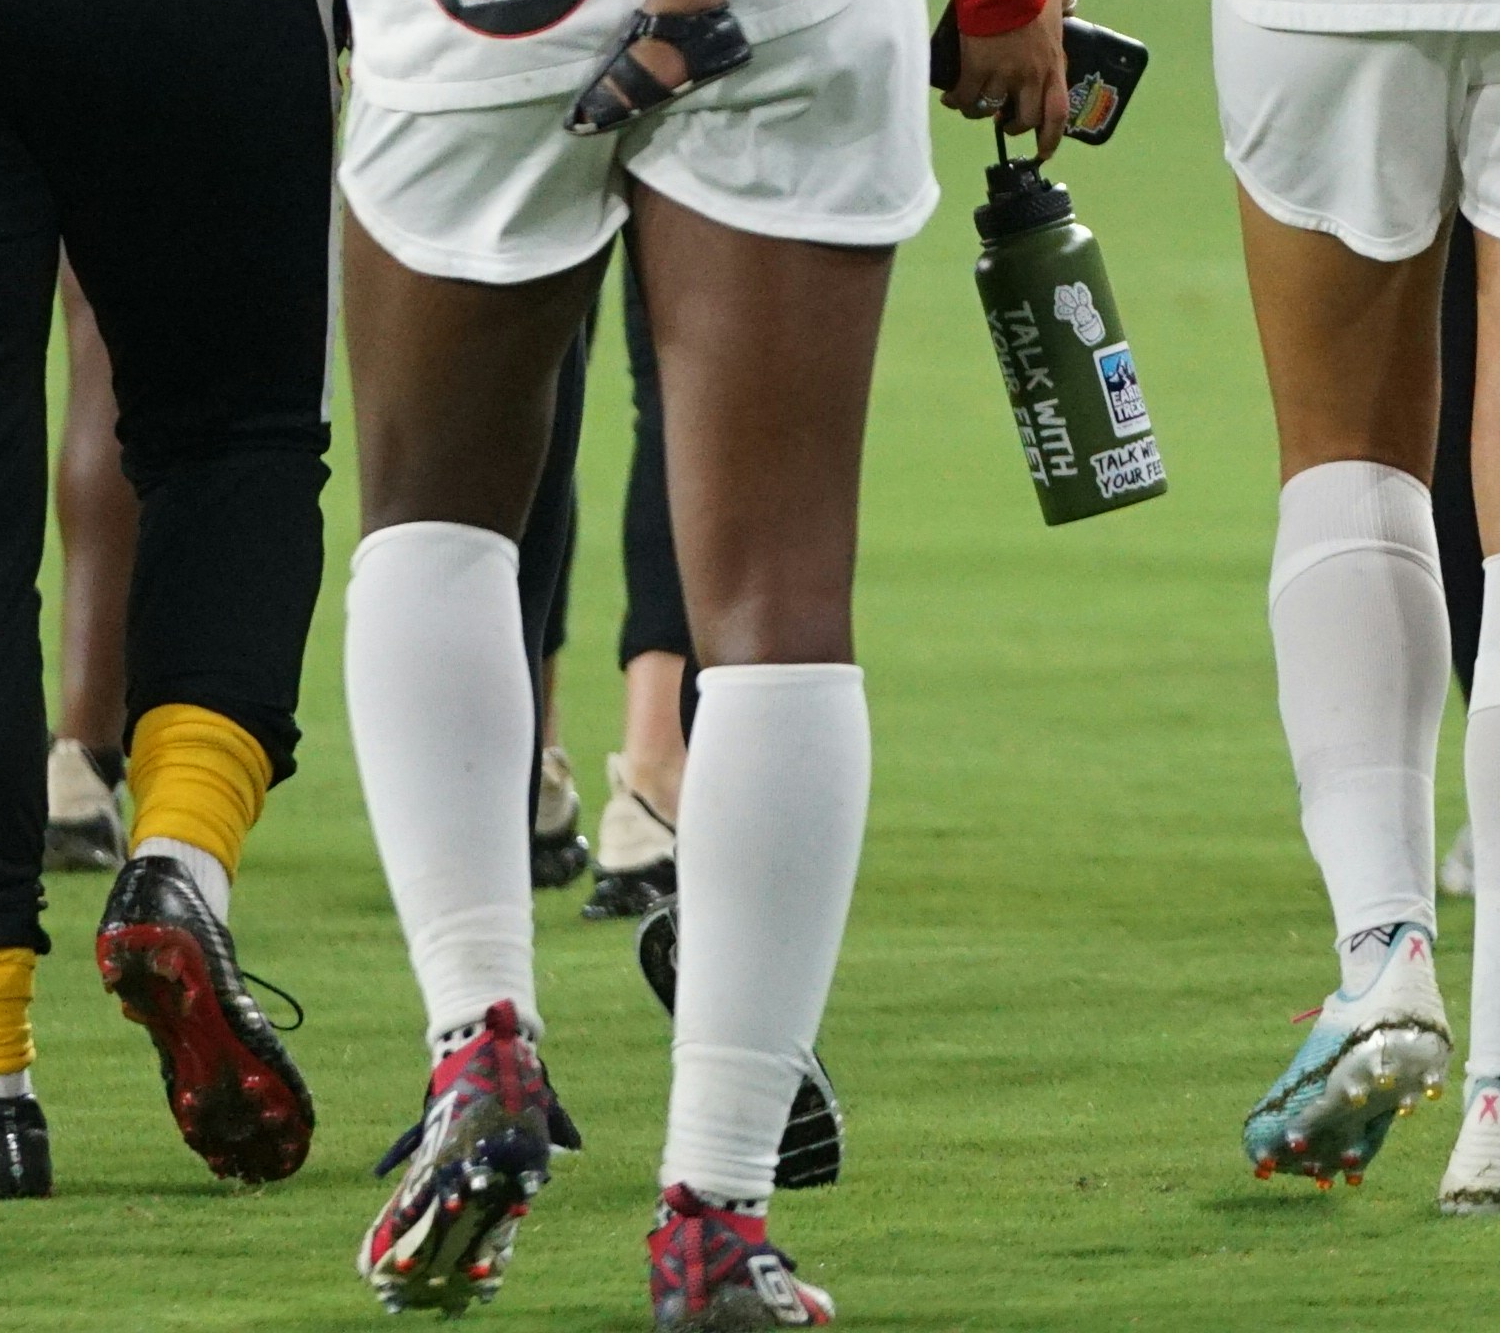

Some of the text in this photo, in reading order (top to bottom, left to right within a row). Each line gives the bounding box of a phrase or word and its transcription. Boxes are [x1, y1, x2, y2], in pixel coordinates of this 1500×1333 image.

[1004, 300, 1078, 476] TALK WITH
[1014, 406, 1050, 487] FEET
[1094, 445, 1139, 475] TALK
[1101, 459, 1162, 494] YOUR FEE
